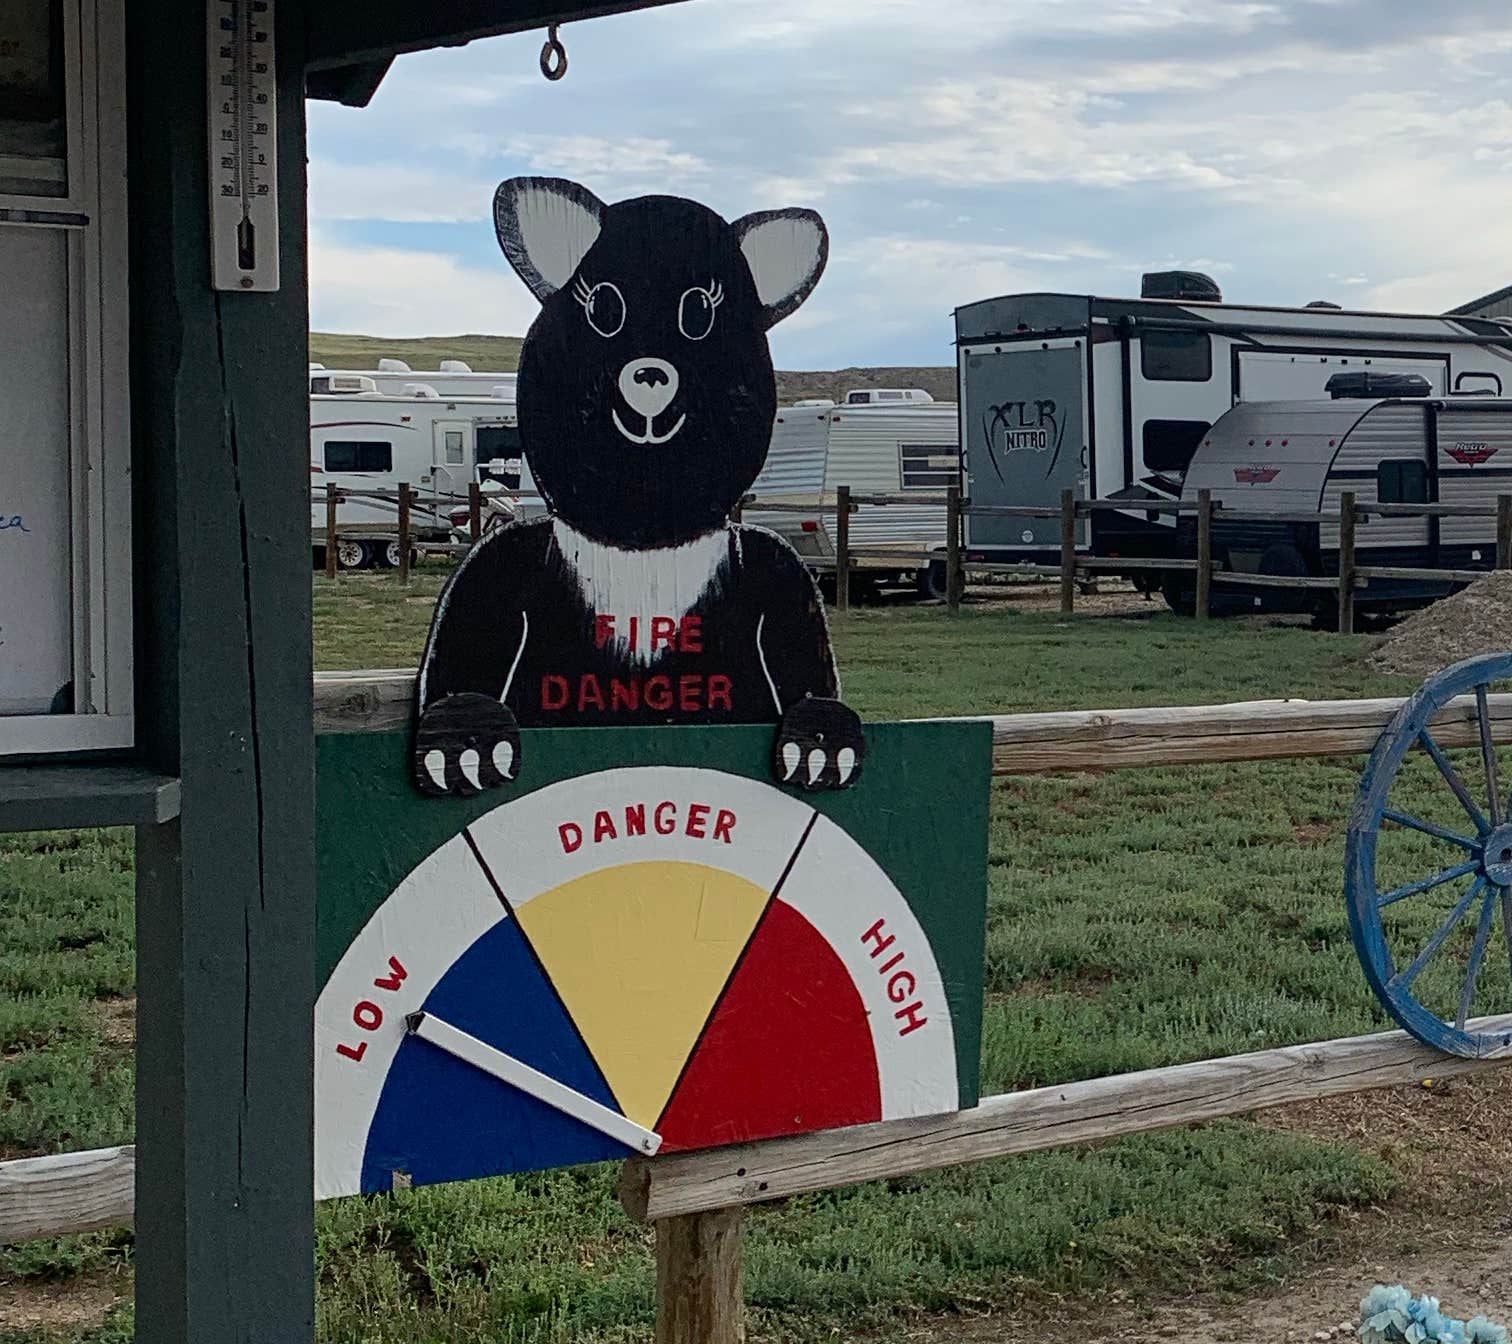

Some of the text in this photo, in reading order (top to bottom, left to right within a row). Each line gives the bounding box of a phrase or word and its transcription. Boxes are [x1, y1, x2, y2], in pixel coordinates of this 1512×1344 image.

[989, 399, 1057, 443] XLR
[1005, 429, 1046, 452] NITRO
[595, 613, 703, 655] FIRE
[540, 674, 734, 712] DANGER
[557, 801, 738, 854] DANGER
[859, 919, 928, 1037] HIGH
[336, 955, 409, 1064] LOW
